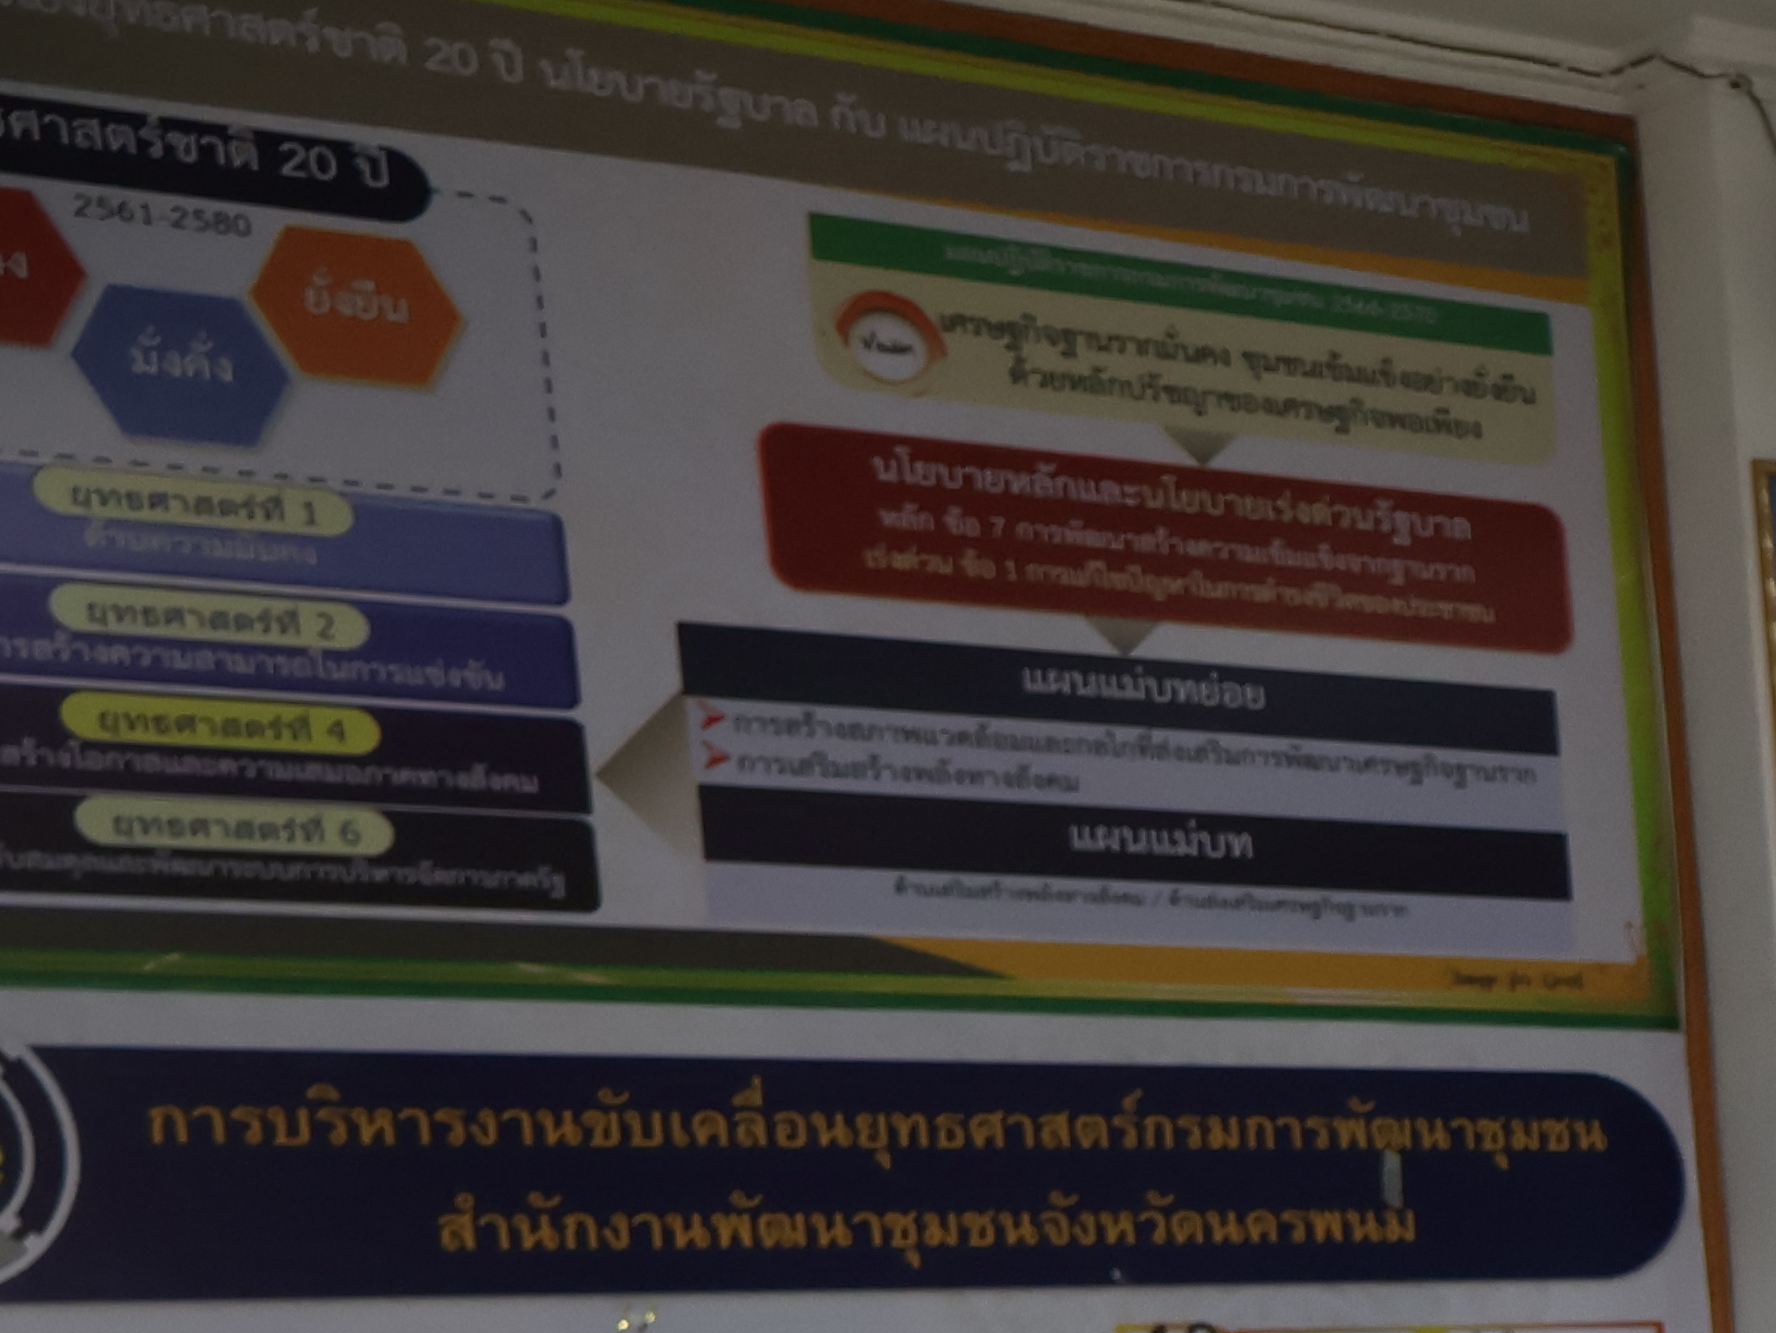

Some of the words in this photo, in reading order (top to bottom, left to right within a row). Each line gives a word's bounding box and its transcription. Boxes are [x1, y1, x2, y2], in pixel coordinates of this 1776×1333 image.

[425, 38, 480, 76] 20
[492, 37, 524, 84] ปี
[540, 49, 818, 129] นโยบายรัฐบาล
[830, 93, 884, 140] กับ
[0, 106, 260, 171] ศาสตร์ชาติ
[278, 142, 338, 181] 20
[350, 140, 390, 189] ปี
[73, 191, 252, 238] 2561-2580
[303, 265, 410, 324] ยั่งยืน
[130, 325, 234, 383] มั่งคั่ง
[71, 478, 286, 526] ยุทธศาสตร์ที่
[303, 500, 317, 526] 1
[871, 453, 1472, 548] นโยบายหลักและนโยบายเร่งด่วนรัฐบาล
[989, 516, 1005, 540] 7
[86, 596, 301, 639] ยุทธศาสตร์ที่
[316, 612, 336, 640] 2
[1021, 663, 1267, 711] แผนแม่บทย่อย
[98, 706, 312, 746] ยุทธศาสตร์ที่
[326, 718, 346, 744] 4
[112, 811, 325, 848] ยุทธศาสตร์ที่
[340, 820, 362, 846] 6
[1068, 818, 1255, 861] แผนแม่บท
[148, 1074, 1608, 1170] การบริหารงานขับเคลื่อนยุทธศาสตร์กรมการพัฒนาชุมชน
[437, 1188, 1415, 1270] สำนักงานพัฒนาชุมชนจังหวัดนครพนม
